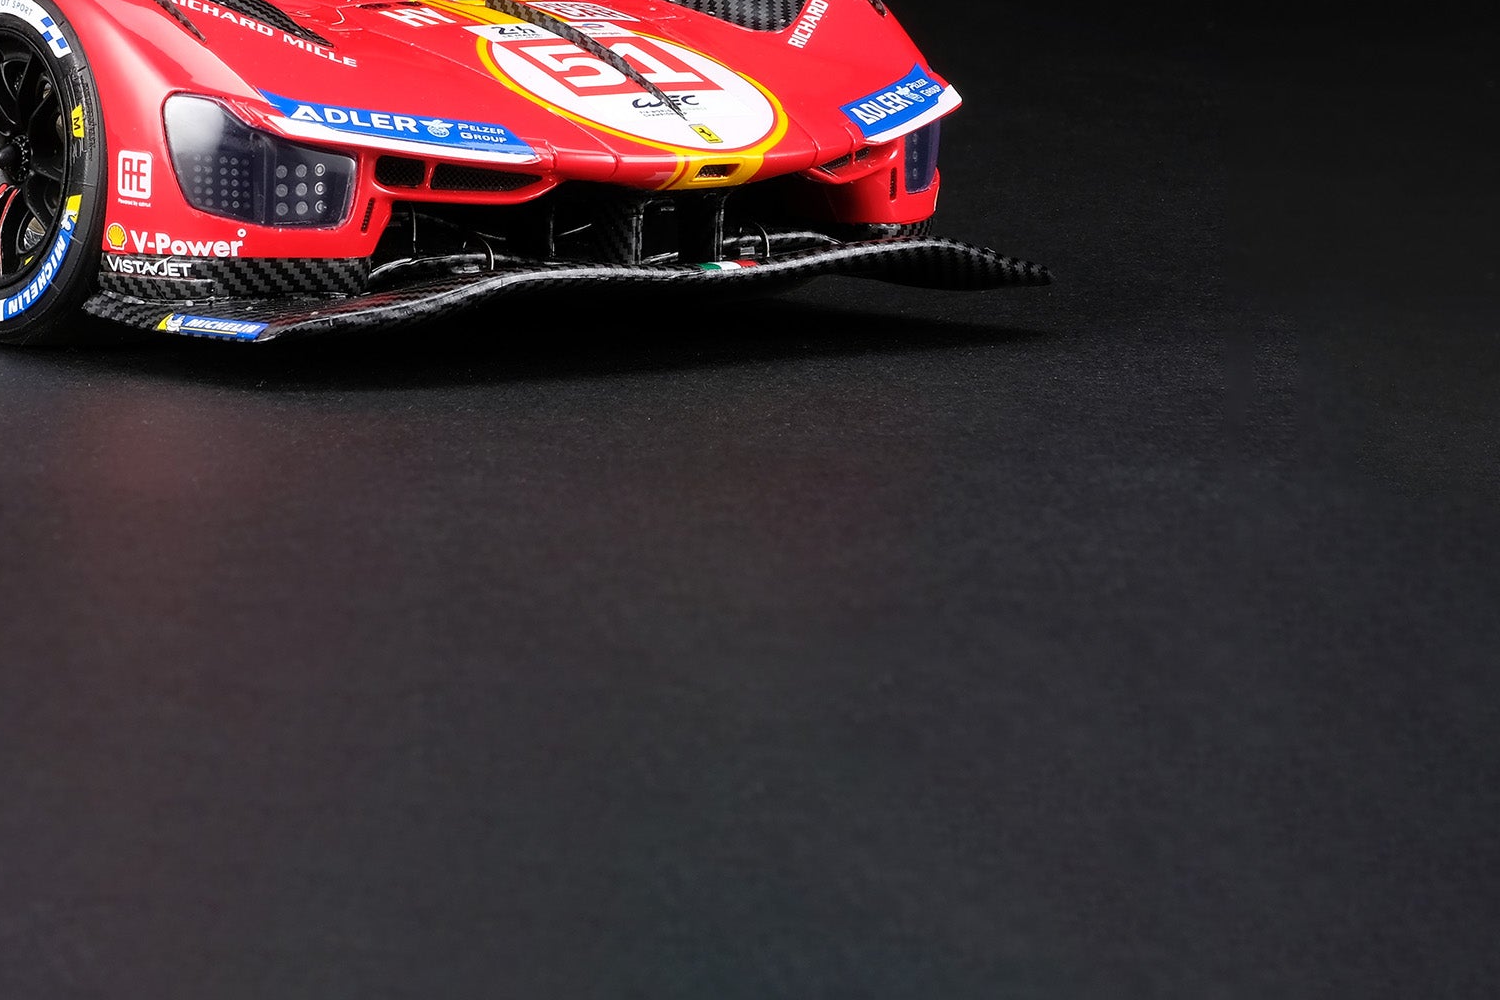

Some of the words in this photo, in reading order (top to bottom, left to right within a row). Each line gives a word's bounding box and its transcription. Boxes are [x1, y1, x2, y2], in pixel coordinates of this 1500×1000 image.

[12, 1, 33, 16] SPORT
[380, 7, 457, 27] HY
[283, 33, 357, 68] MILLE
[519, 42, 705, 88] 51
[290, 104, 419, 133] ADLER
[850, 90, 914, 126] ADLER
[73, 117, 81, 130] M
[457, 123, 505, 135] PELZER
[459, 131, 507, 143] GROUP
[130, 229, 243, 258] V-Power
[8, 236, 66, 315] MICHELIN
[185, 319, 260, 334] MICHELIN
